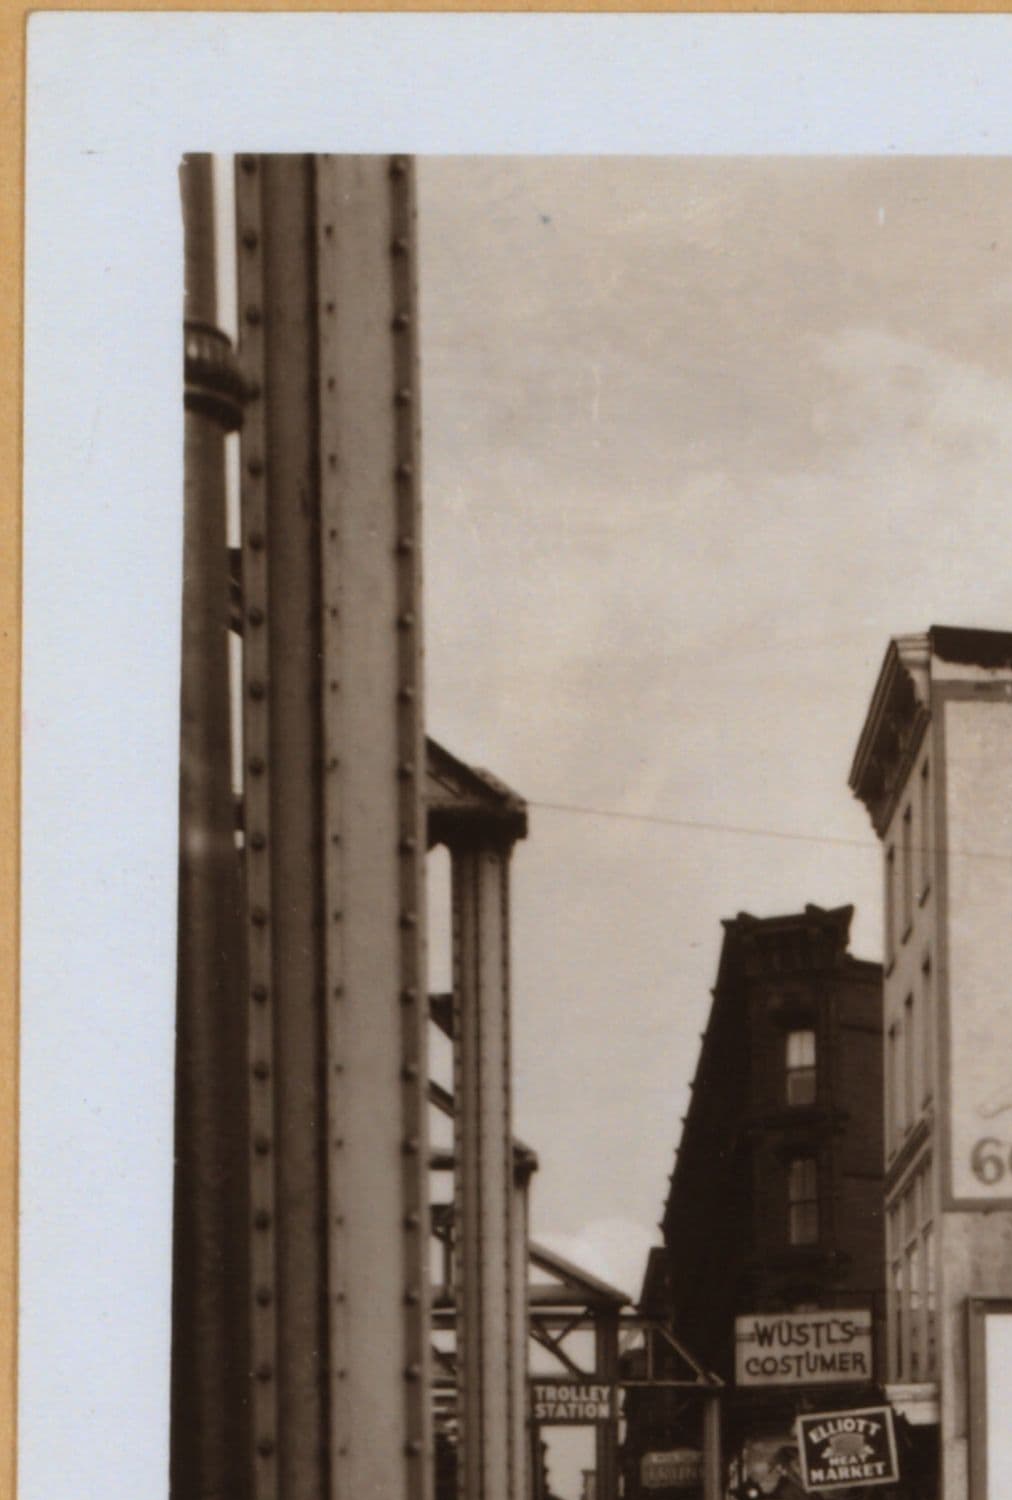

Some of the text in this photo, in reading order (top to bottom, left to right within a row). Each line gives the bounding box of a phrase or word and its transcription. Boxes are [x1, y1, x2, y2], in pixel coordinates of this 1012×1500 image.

[745, 1351, 868, 1378] COSTUMER
[534, 1384, 610, 1402] TROLLEY
[535, 1402, 610, 1418] STATION
[808, 1418, 881, 1444] ELLIOTT
[810, 1462, 886, 1482] MARKET
